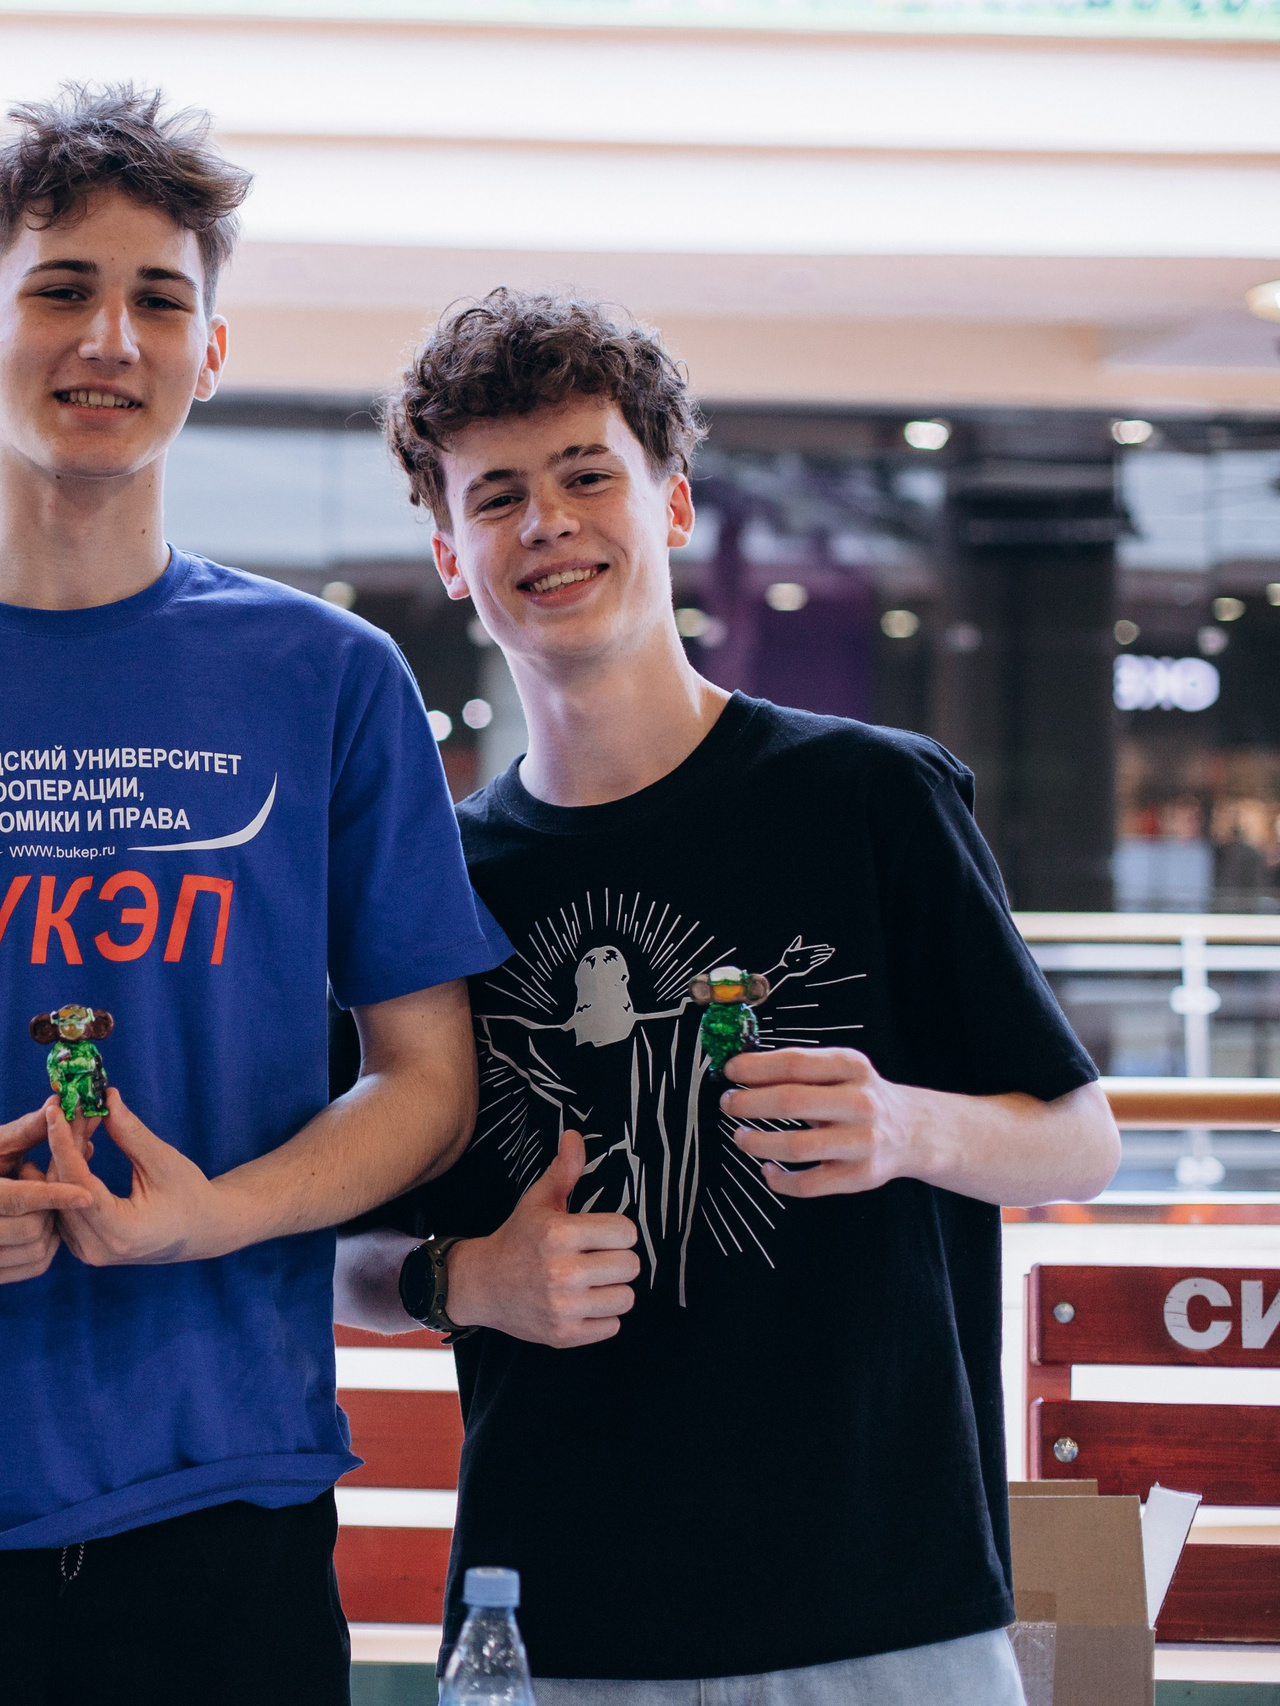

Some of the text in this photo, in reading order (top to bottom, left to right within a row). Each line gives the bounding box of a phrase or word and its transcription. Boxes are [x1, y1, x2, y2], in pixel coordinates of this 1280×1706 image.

[72, 747, 242, 775] УНИВЕРСИТЕТ
[87, 809, 103, 832] И
[109, 807, 191, 831] ПРАВА
